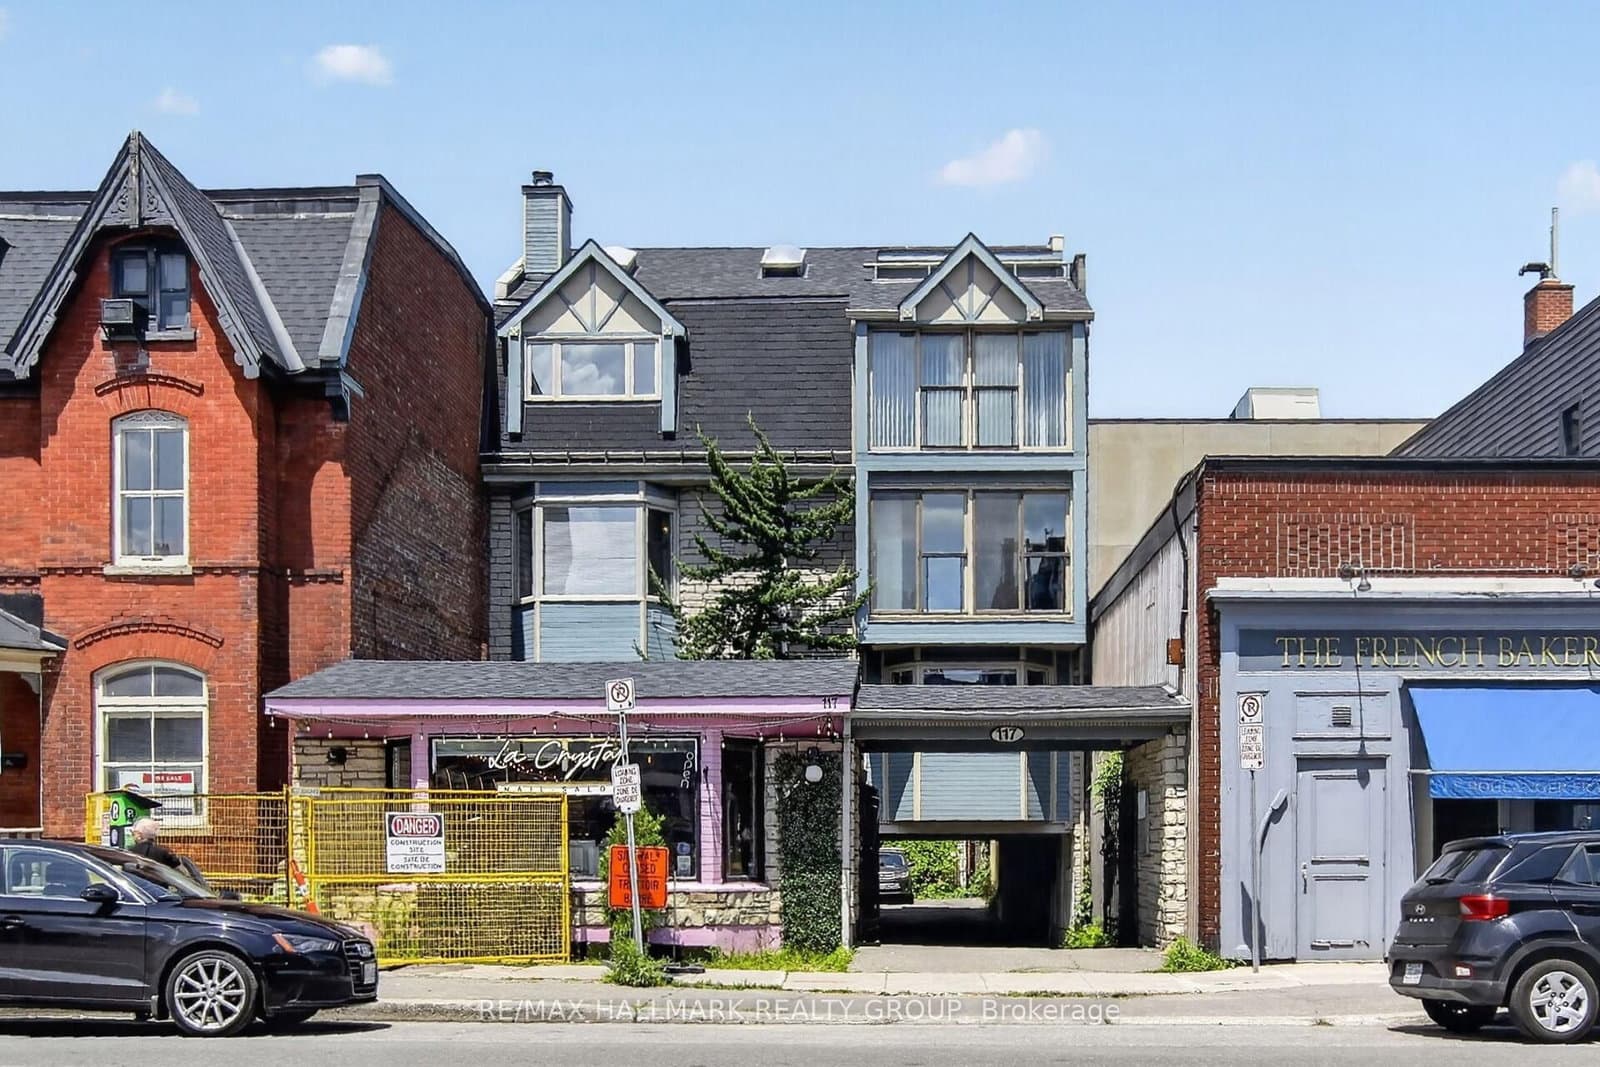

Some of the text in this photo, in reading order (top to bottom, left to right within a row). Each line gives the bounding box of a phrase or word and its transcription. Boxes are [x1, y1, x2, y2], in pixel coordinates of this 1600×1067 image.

[1276, 636, 1600, 668] THE FRENCH BAKER
[822, 697, 838, 709] 117
[996, 727, 1017, 740] 117
[488, 740, 527, 769] La
[396, 818, 435, 834] DANGER
[622, 863, 656, 874] CSED
